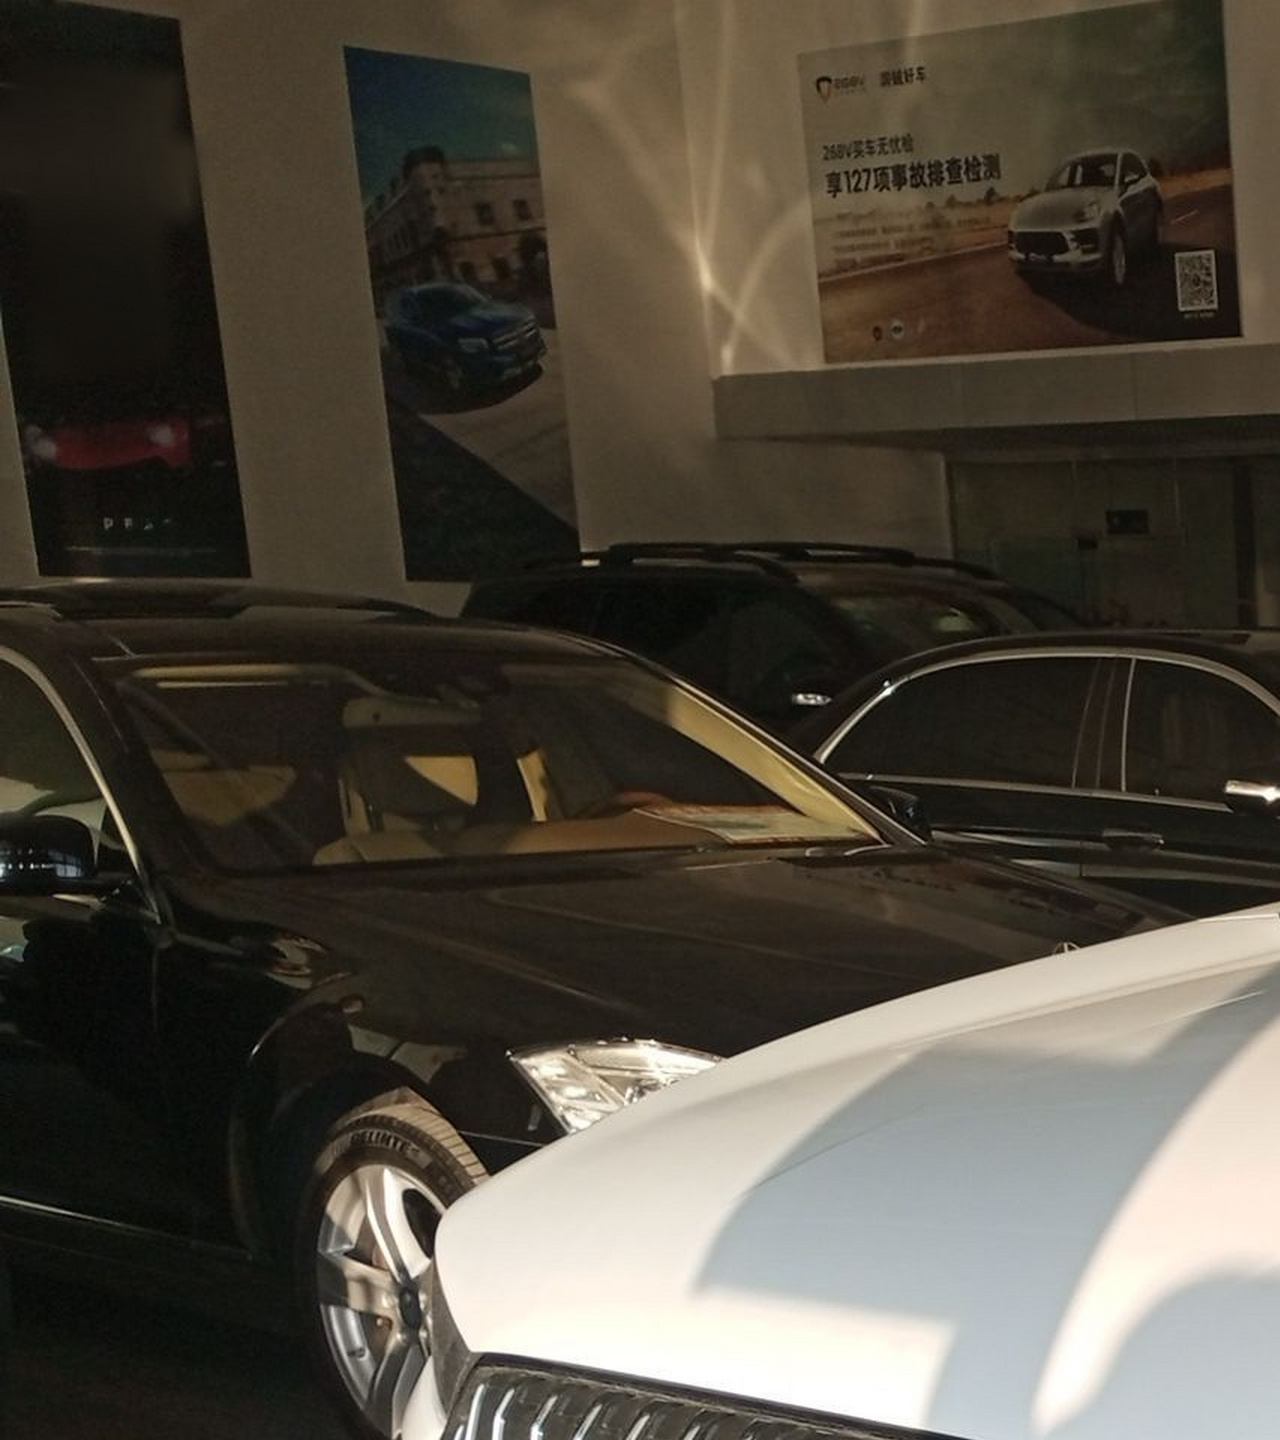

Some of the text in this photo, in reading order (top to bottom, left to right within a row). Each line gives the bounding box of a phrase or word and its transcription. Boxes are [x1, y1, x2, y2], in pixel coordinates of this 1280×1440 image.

[825, 153, 1001, 198] 享127项事故排查检测
